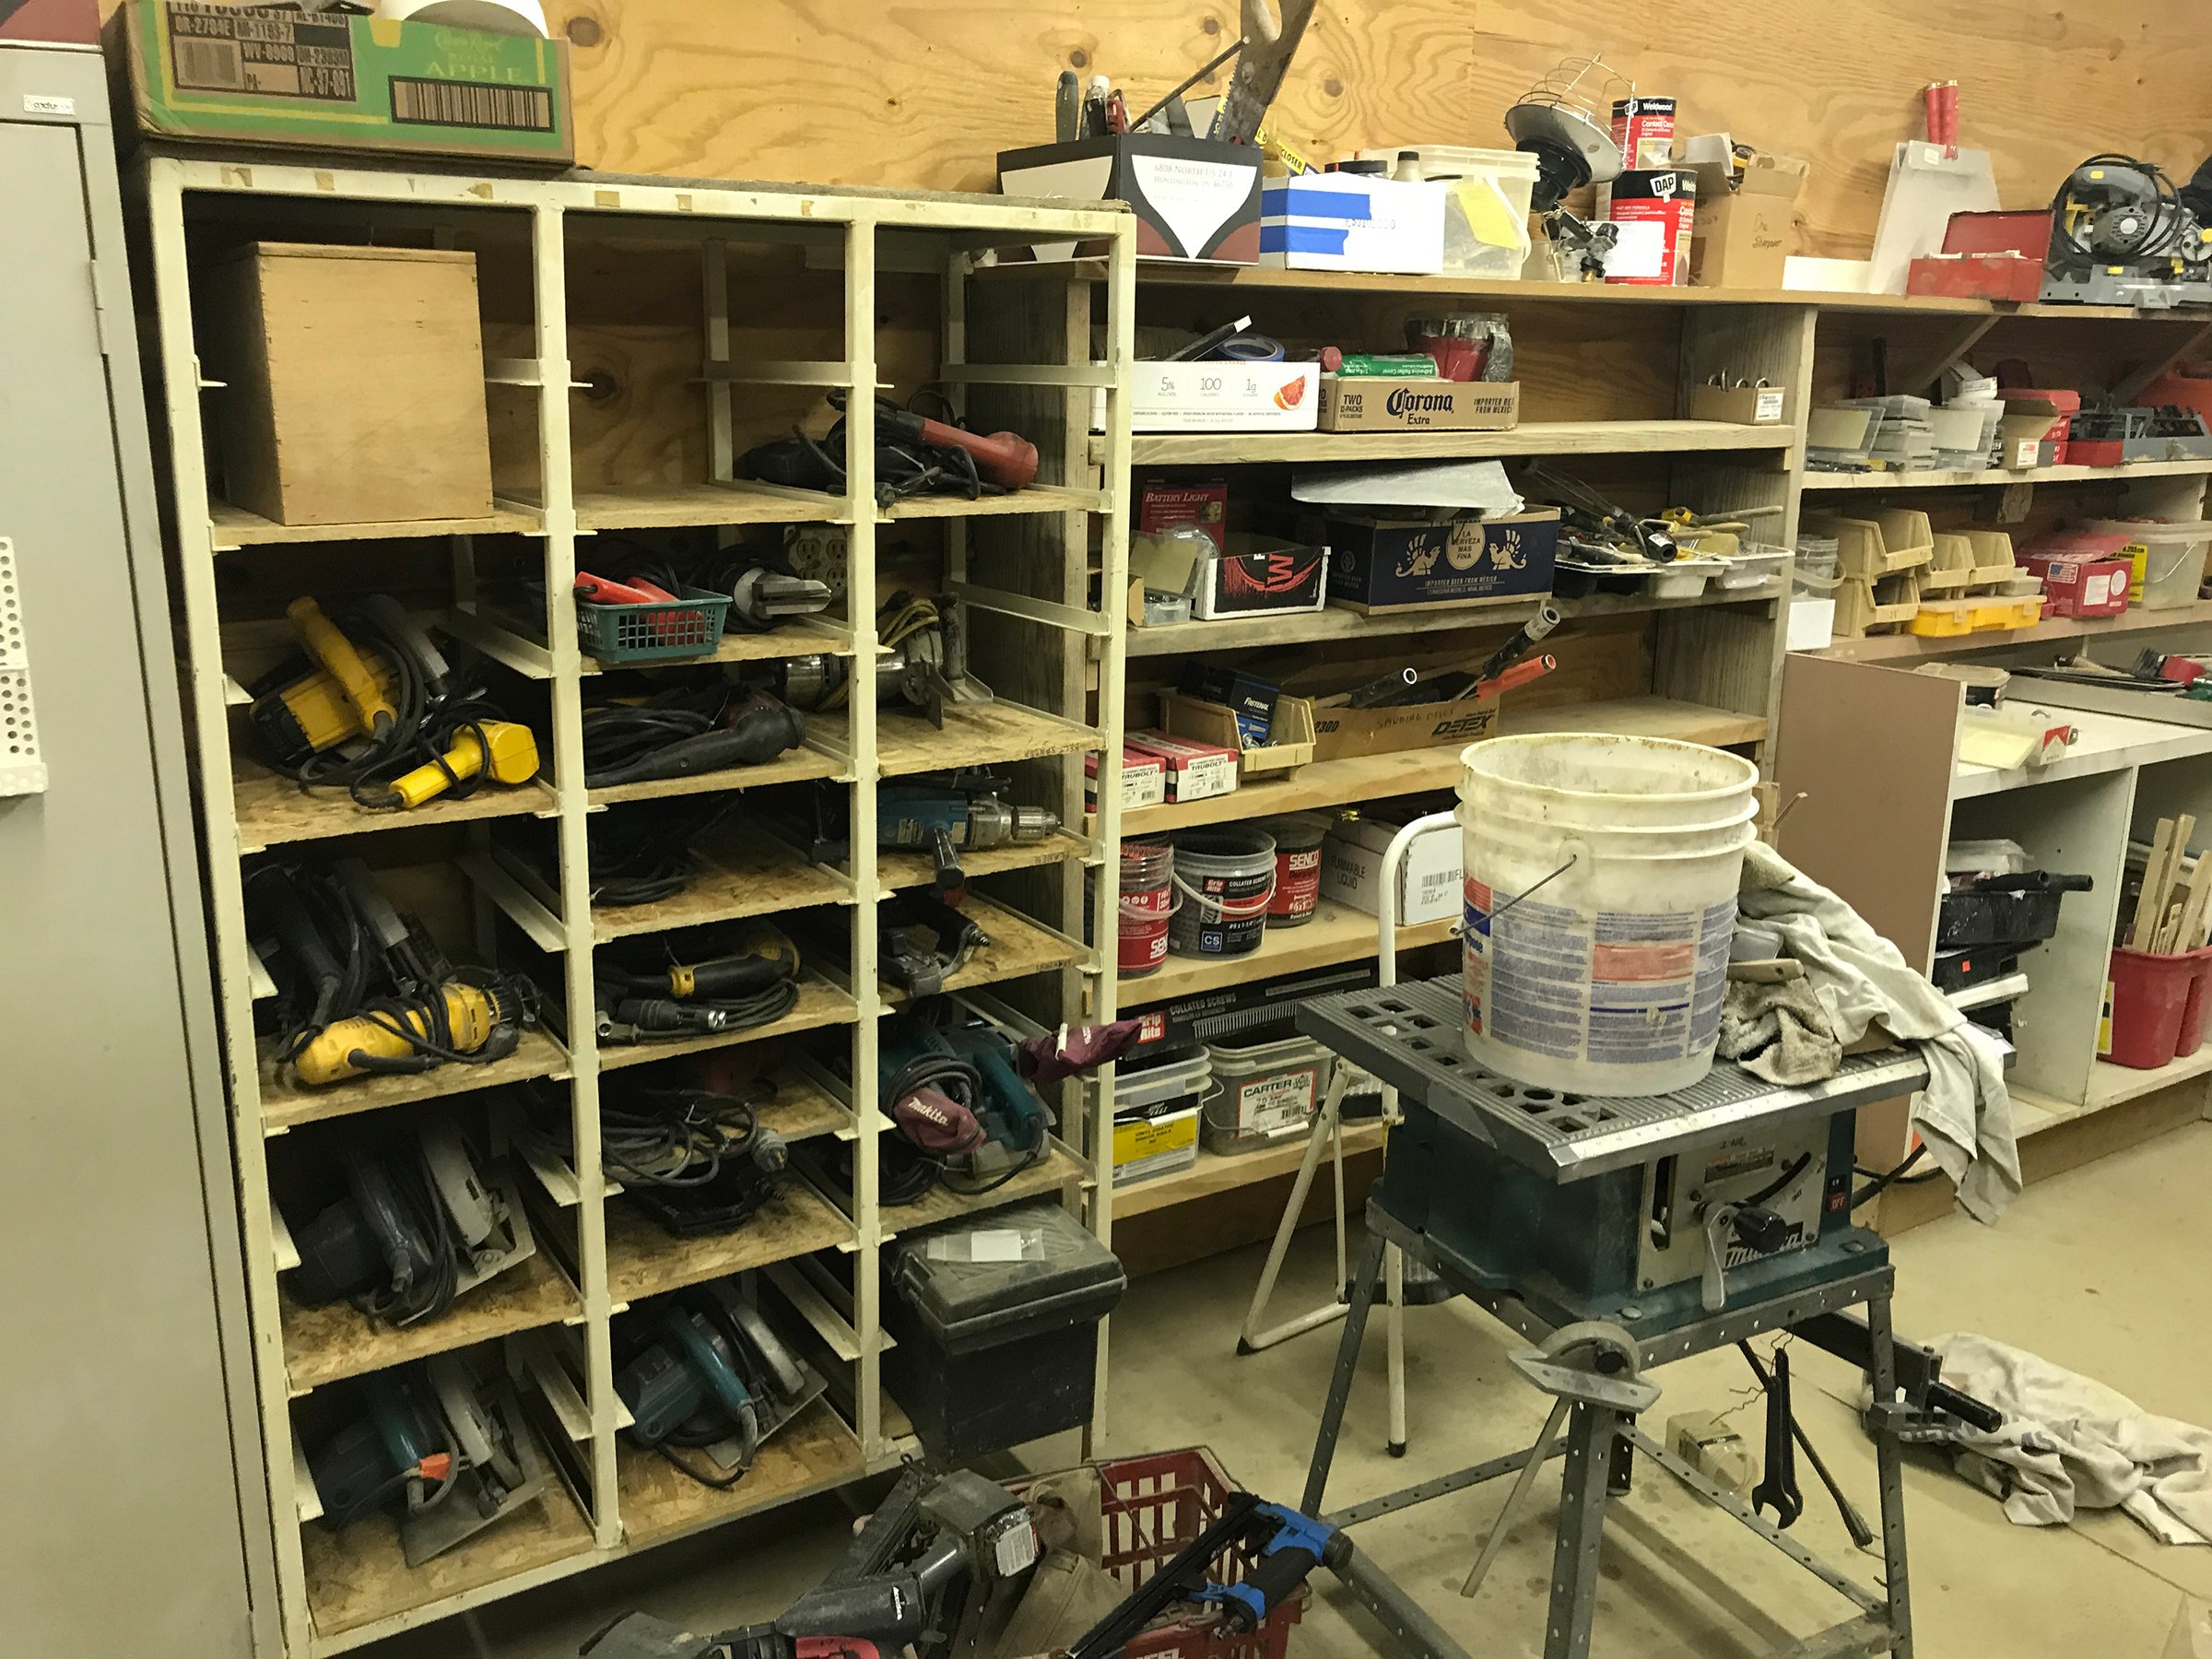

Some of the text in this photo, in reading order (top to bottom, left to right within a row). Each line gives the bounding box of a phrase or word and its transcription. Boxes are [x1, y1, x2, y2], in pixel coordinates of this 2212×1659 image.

[427, 61, 523, 82] APPLE
[1642, 102, 1673, 111] Weldwood
[1280, 147, 1303, 171] CLOSER
[1654, 177, 1675, 194] DAP
[1200, 377, 1222, 391] 100
[1245, 378, 1256, 393] 1g
[1343, 394, 1362, 406] TWO
[1385, 387, 1454, 418] Corona
[1474, 397, 1502, 406] IMPORTED
[1476, 406, 1492, 414] FROM
[1406, 413, 1430, 426] Extra
[1145, 492, 1209, 502] BATTERY LIGHT
[1454, 537, 1481, 546] ERVEZA
[1244, 697, 1270, 711] FASTENAL
[1430, 715, 1493, 736] DETEX
[1191, 761, 1224, 771] TRUBOLT
[1289, 850, 1320, 867] SENCO
[1229, 879, 1253, 888] COLLATED
[1204, 935, 1220, 946] CS
[1170, 1001, 1206, 1016] COLLATED
[1206, 992, 1237, 1007] SCREWS
[1139, 1027, 1161, 1041] Rite
[1243, 1079, 1292, 1099] CARTER
